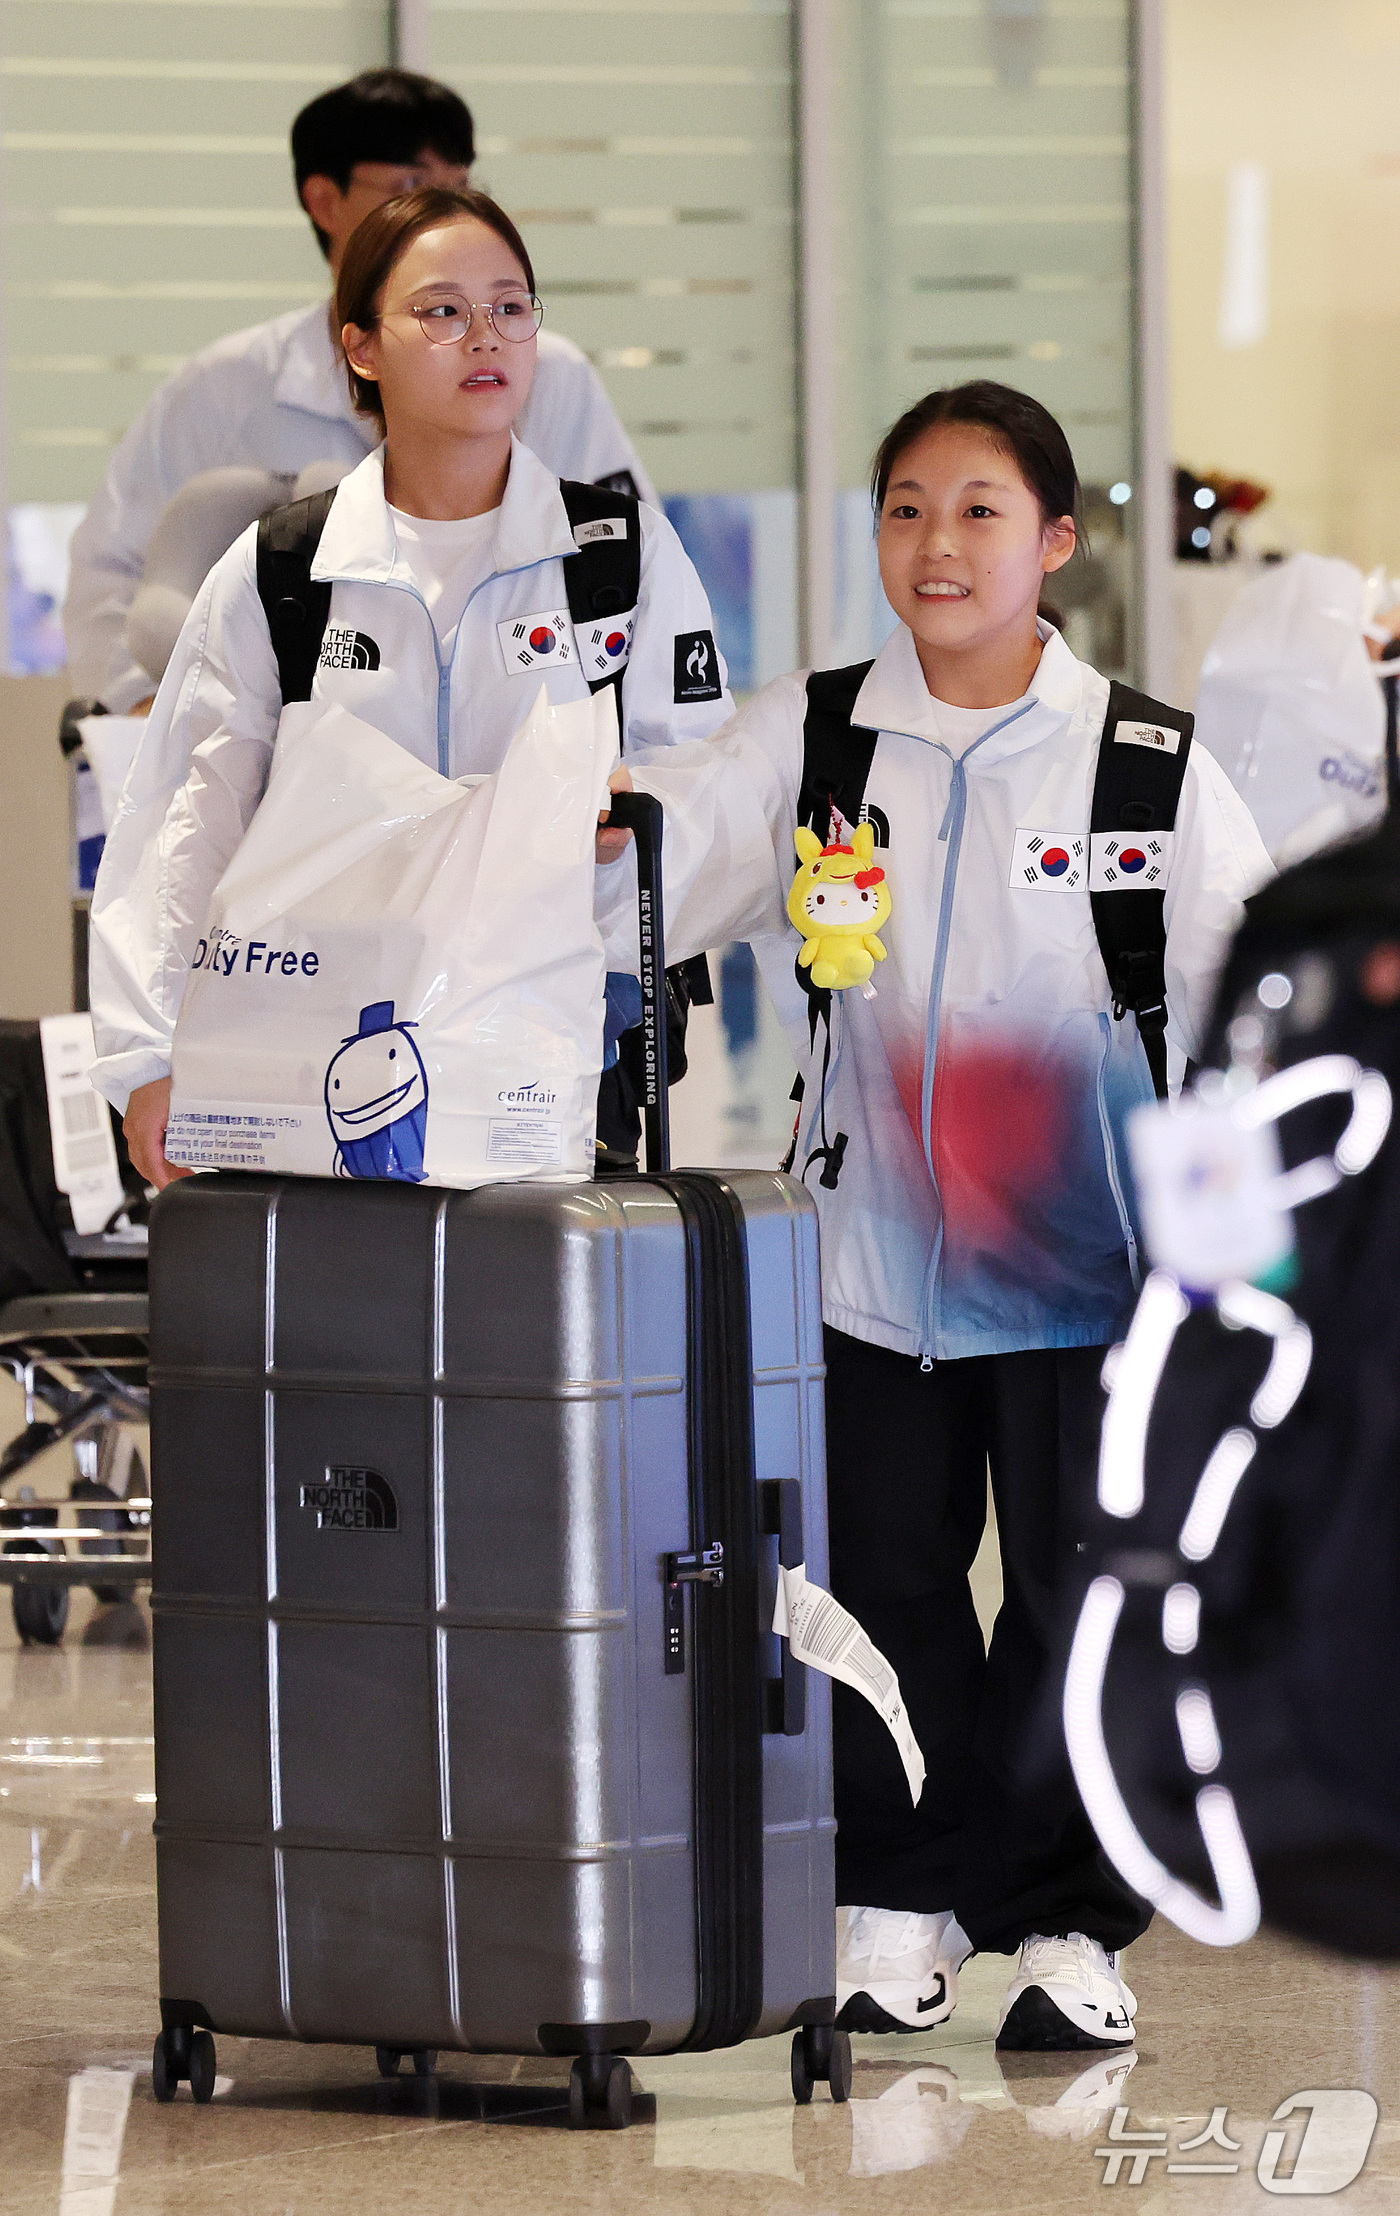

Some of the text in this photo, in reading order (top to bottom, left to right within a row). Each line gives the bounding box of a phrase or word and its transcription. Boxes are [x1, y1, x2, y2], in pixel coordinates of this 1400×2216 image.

[328, 628, 355, 643] THE
[320, 641, 353, 656] ORTH
[320, 655, 351, 669] FACE
[245, 941, 319, 976] Free
[640, 889, 657, 1105] NEVER STOP EXPLORING
[497, 1085, 556, 1103] centrair
[331, 1469, 365, 1488] THE
[304, 1487, 364, 1507] NORTH
[322, 1507, 365, 1528] FACE
